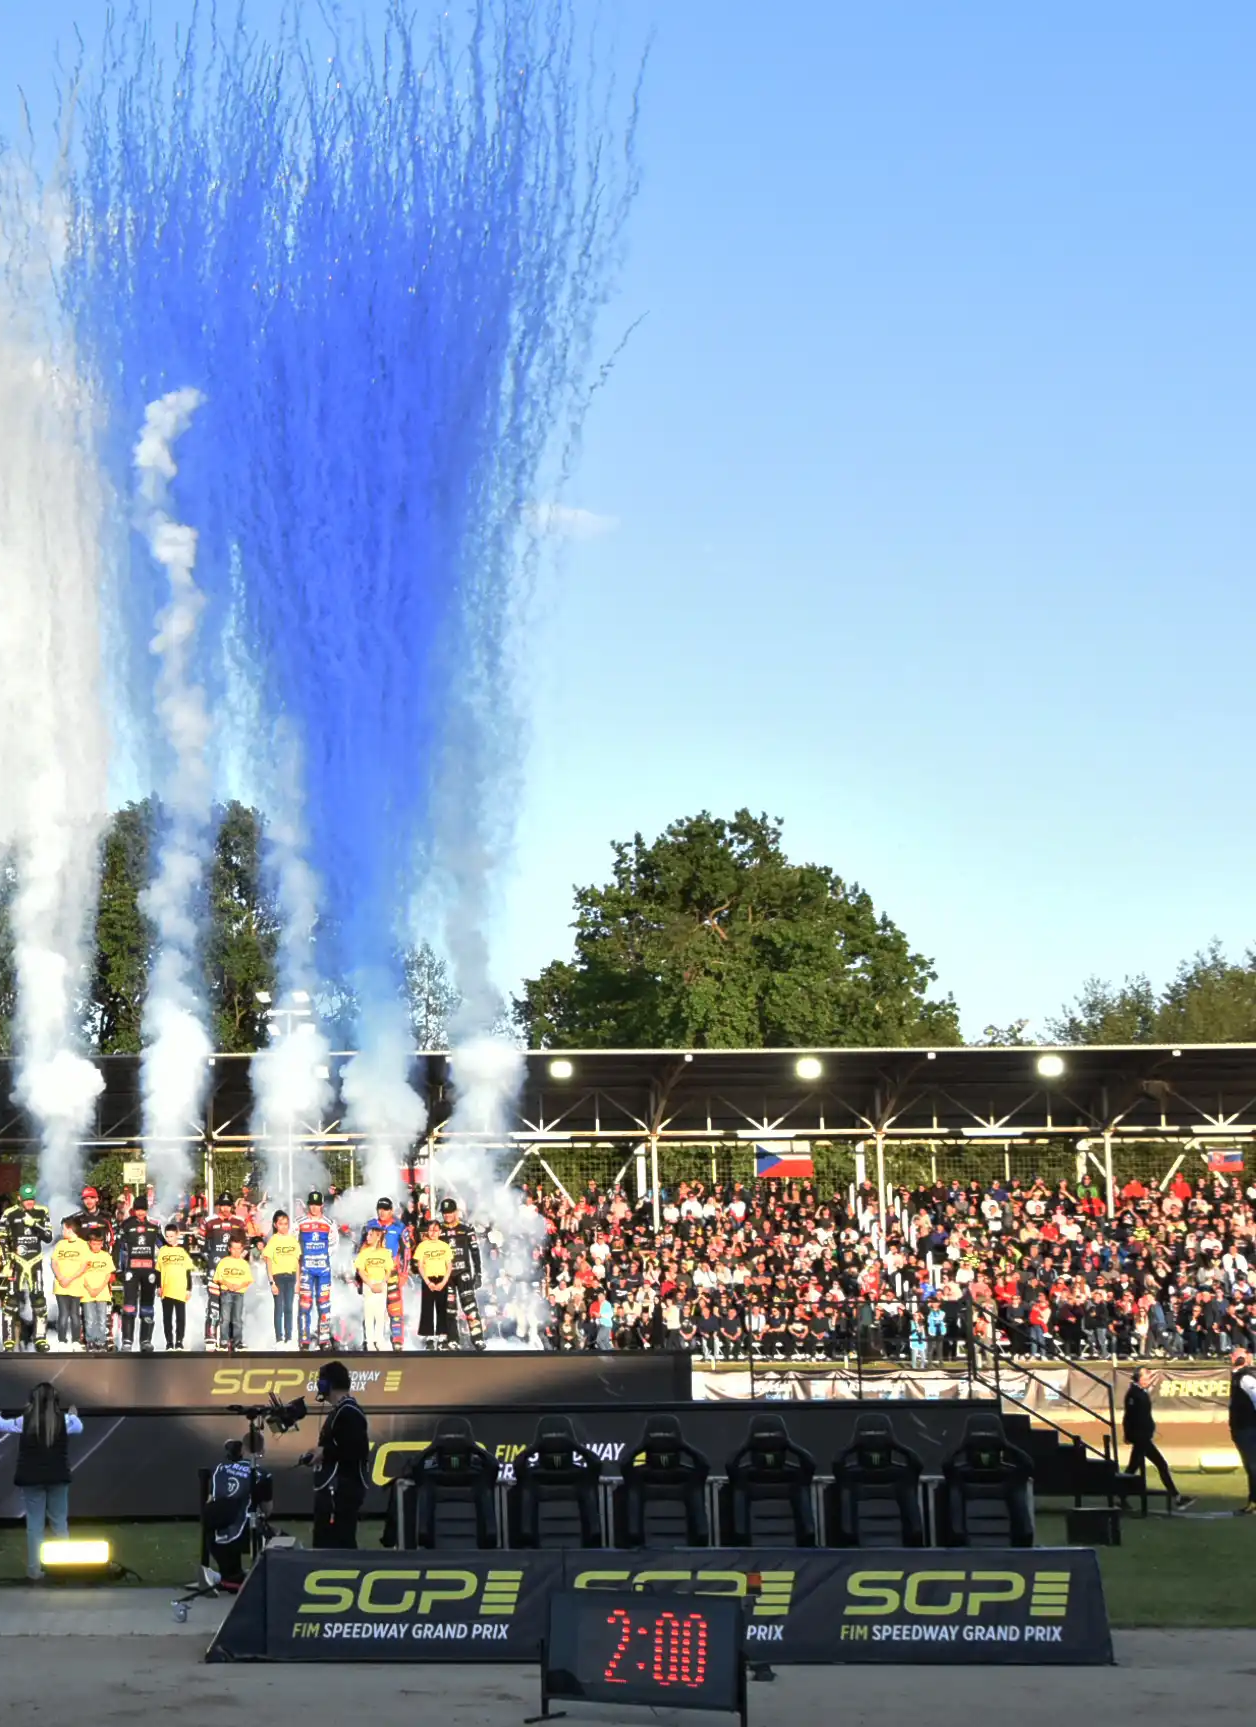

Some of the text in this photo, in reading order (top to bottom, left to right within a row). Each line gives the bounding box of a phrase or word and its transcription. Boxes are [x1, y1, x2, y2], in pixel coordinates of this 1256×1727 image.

[211, 1369, 304, 1394] SGP
[297, 1569, 478, 1614] SGP
[843, 1571, 1026, 1616] SGP
[292, 1623, 509, 1640] FIM SPEEDWAY GRAND PRIX
[746, 1625, 785, 1641] PRIX
[840, 1625, 1063, 1642] FIM SPEEDWAY GRAND PRIX
[604, 1609, 708, 1688] 2:00
